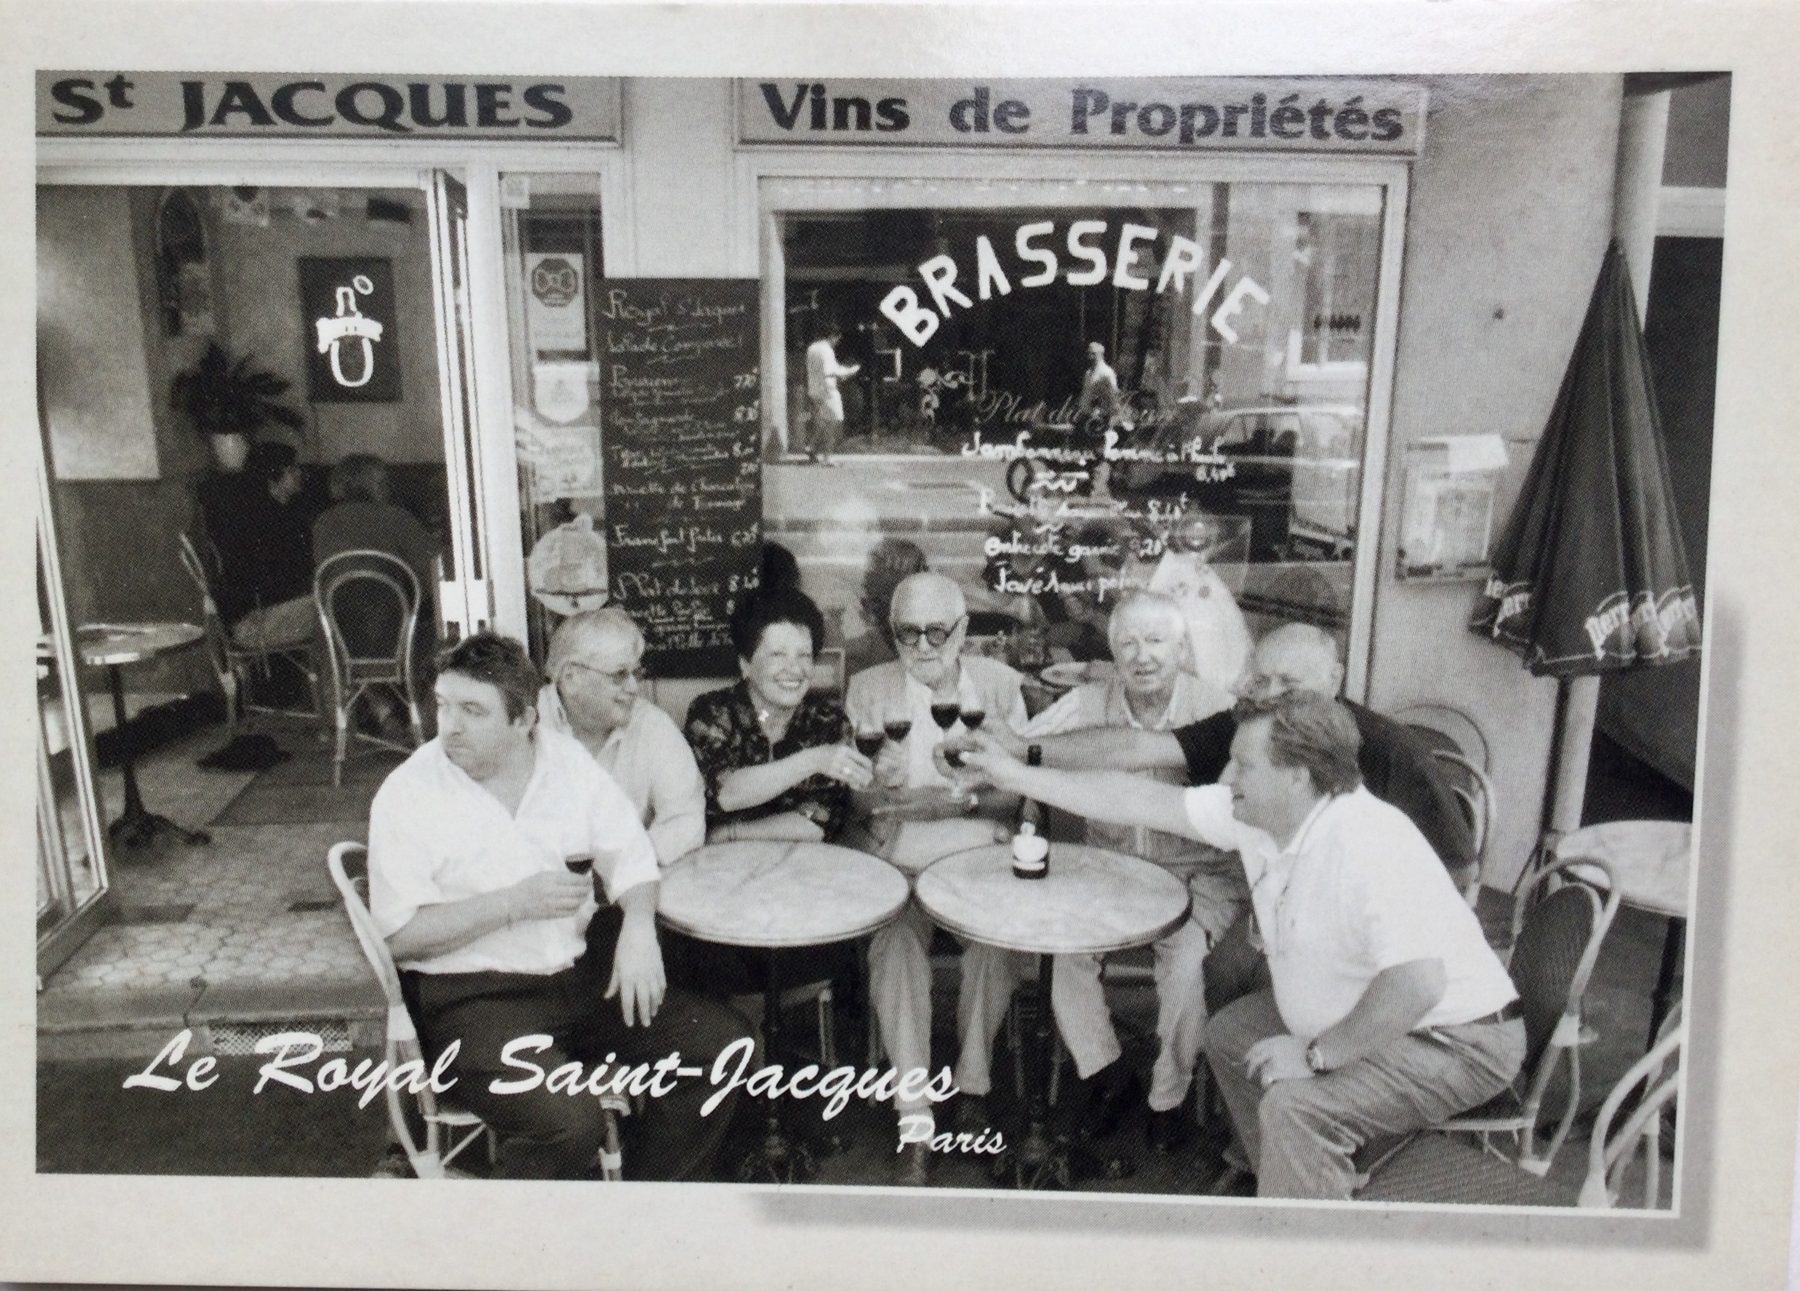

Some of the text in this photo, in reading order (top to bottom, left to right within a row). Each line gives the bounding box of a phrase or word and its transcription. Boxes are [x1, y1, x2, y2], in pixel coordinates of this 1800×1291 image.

[50, 74, 574, 132] St JACQUES
[759, 83, 1404, 144] Vins de Propriétés
[878, 220, 1271, 348] BRASSERIE
